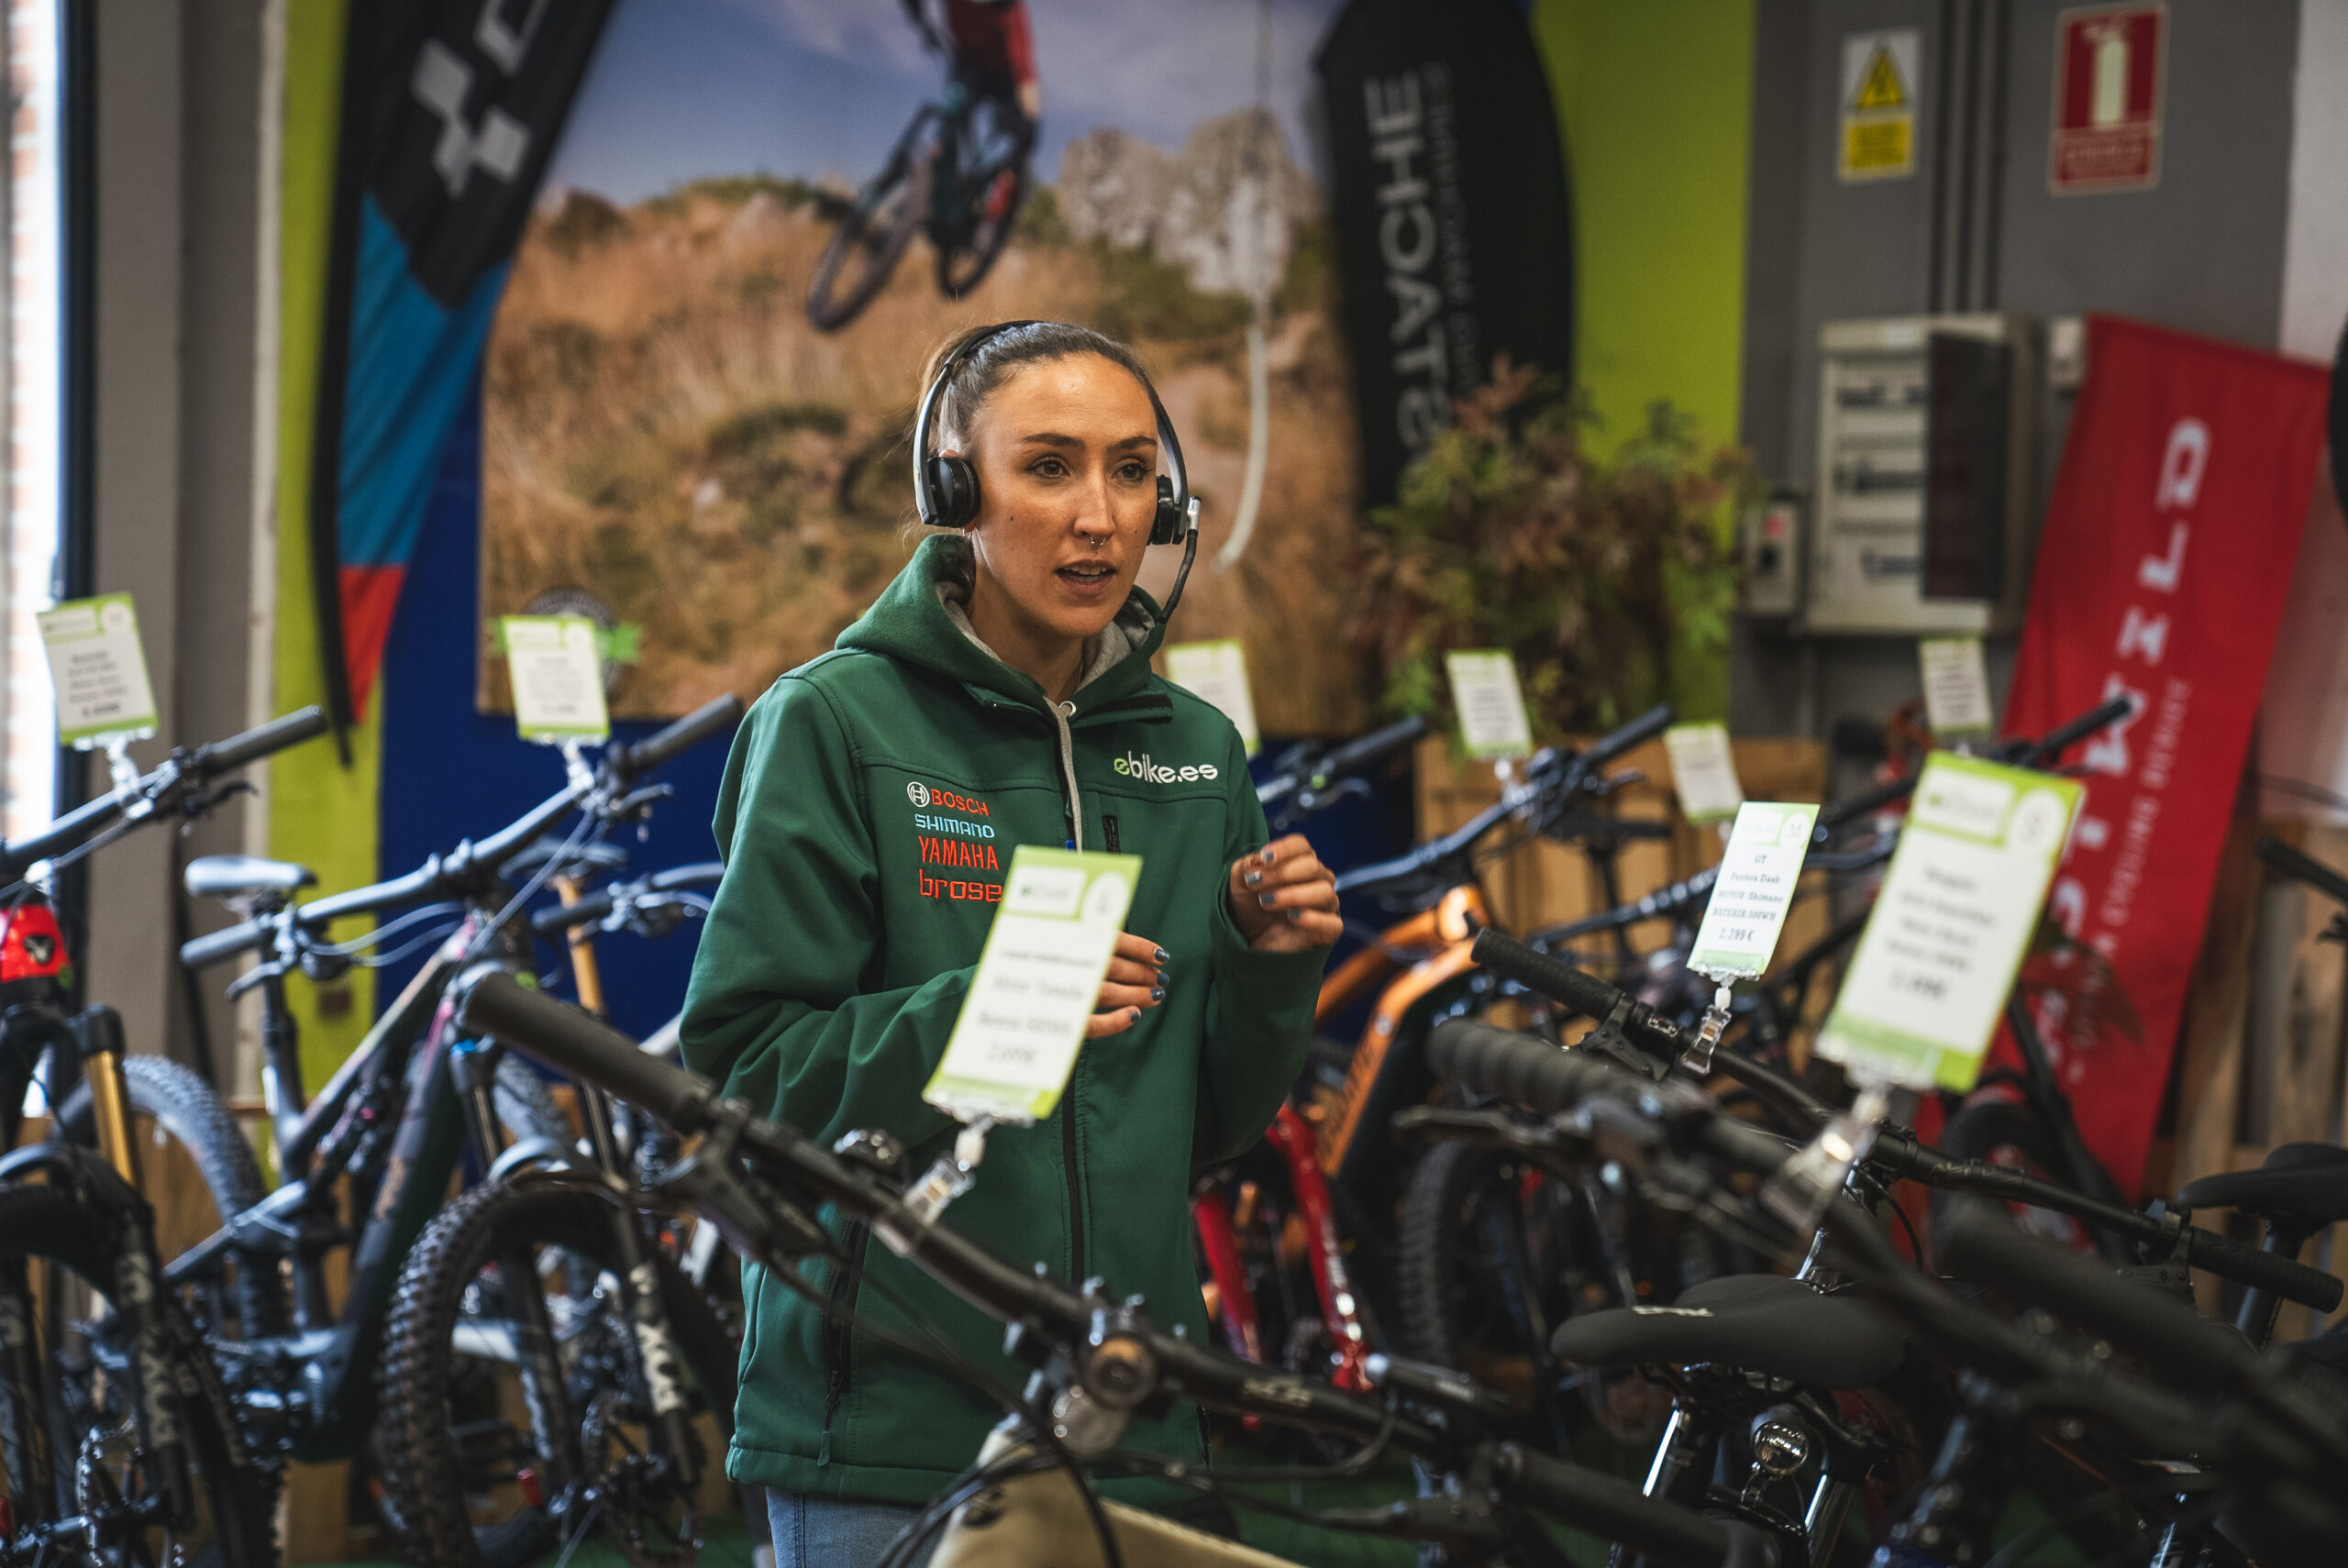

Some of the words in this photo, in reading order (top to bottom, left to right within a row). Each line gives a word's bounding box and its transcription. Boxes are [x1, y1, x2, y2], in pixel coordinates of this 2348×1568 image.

[1113, 750, 1219, 784] ebike.es
[931, 788, 990, 817] BOSCH
[914, 813, 995, 838] SHIMANO
[918, 835, 1000, 870] YAMAHA
[919, 868, 1002, 902] brose
